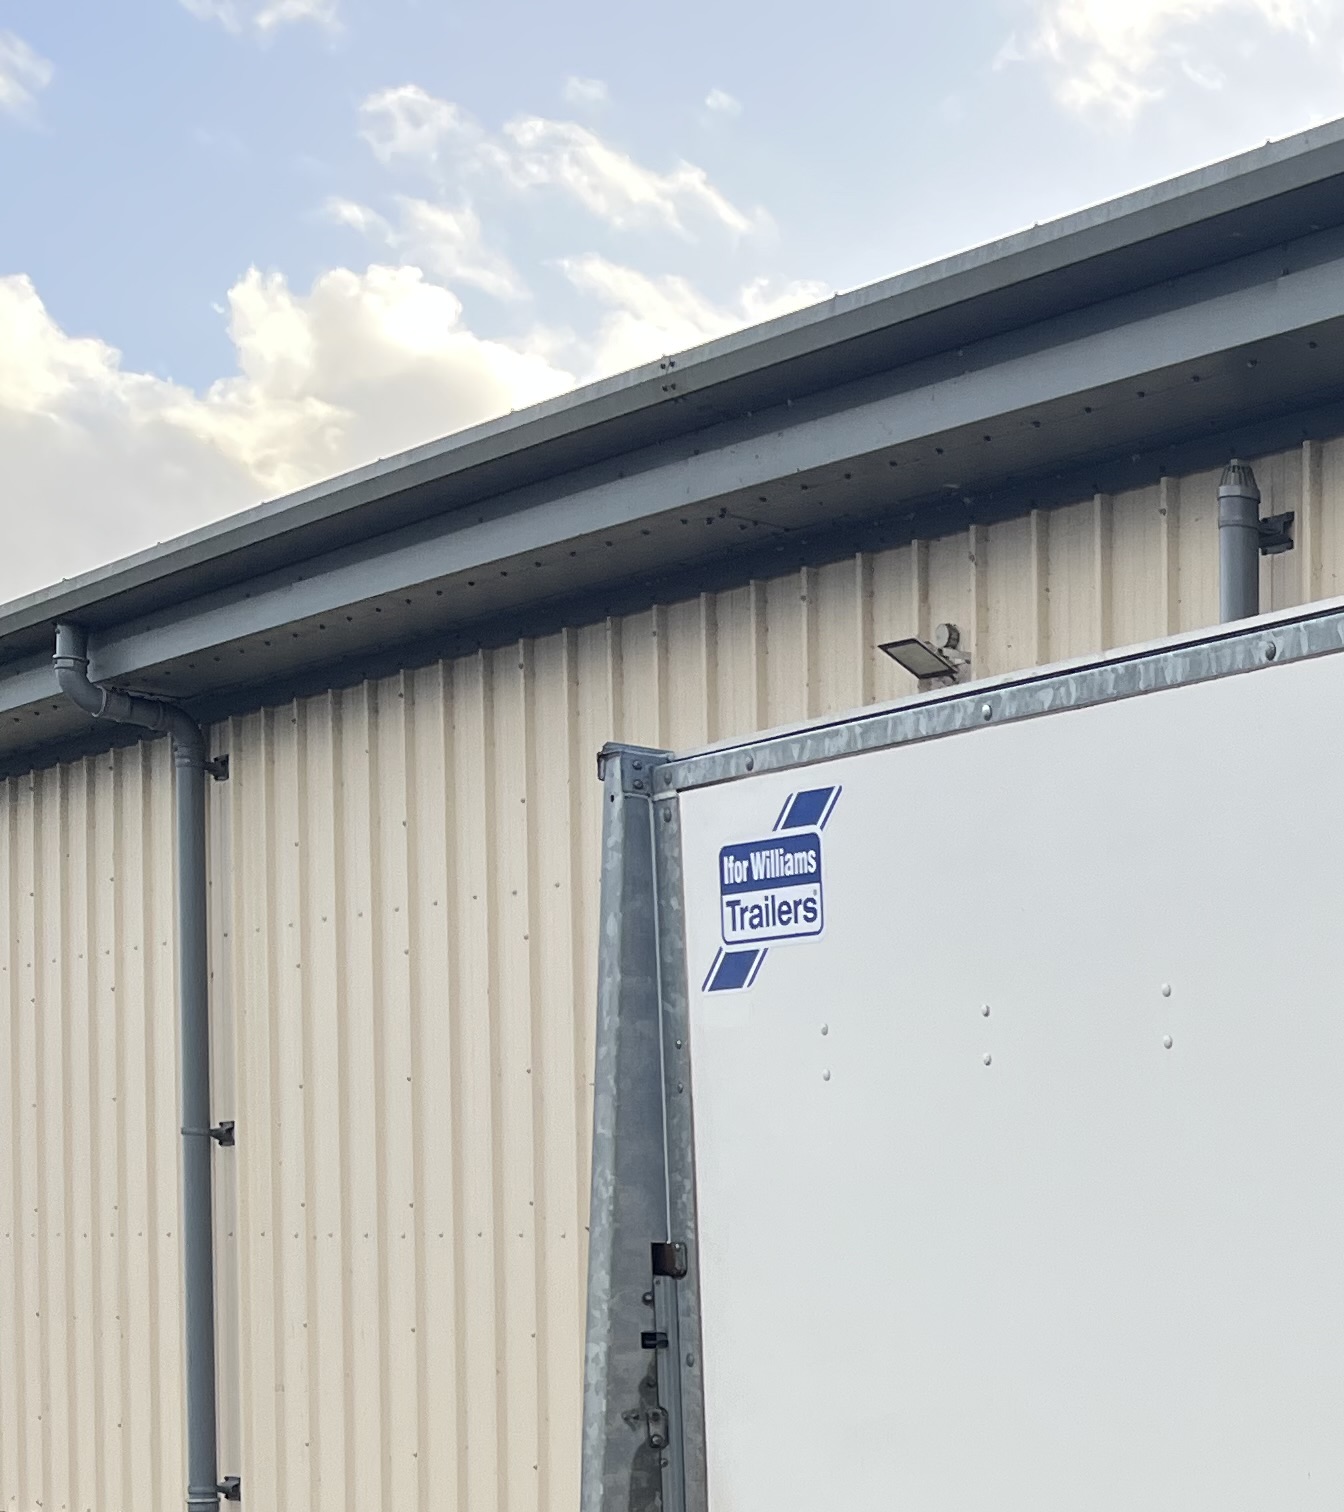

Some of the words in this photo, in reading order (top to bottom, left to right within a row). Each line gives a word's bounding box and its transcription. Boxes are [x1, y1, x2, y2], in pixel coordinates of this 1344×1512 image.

[724, 855, 749, 885] Ifor
[750, 848, 817, 881] Williams
[726, 895, 818, 931] Trailers
